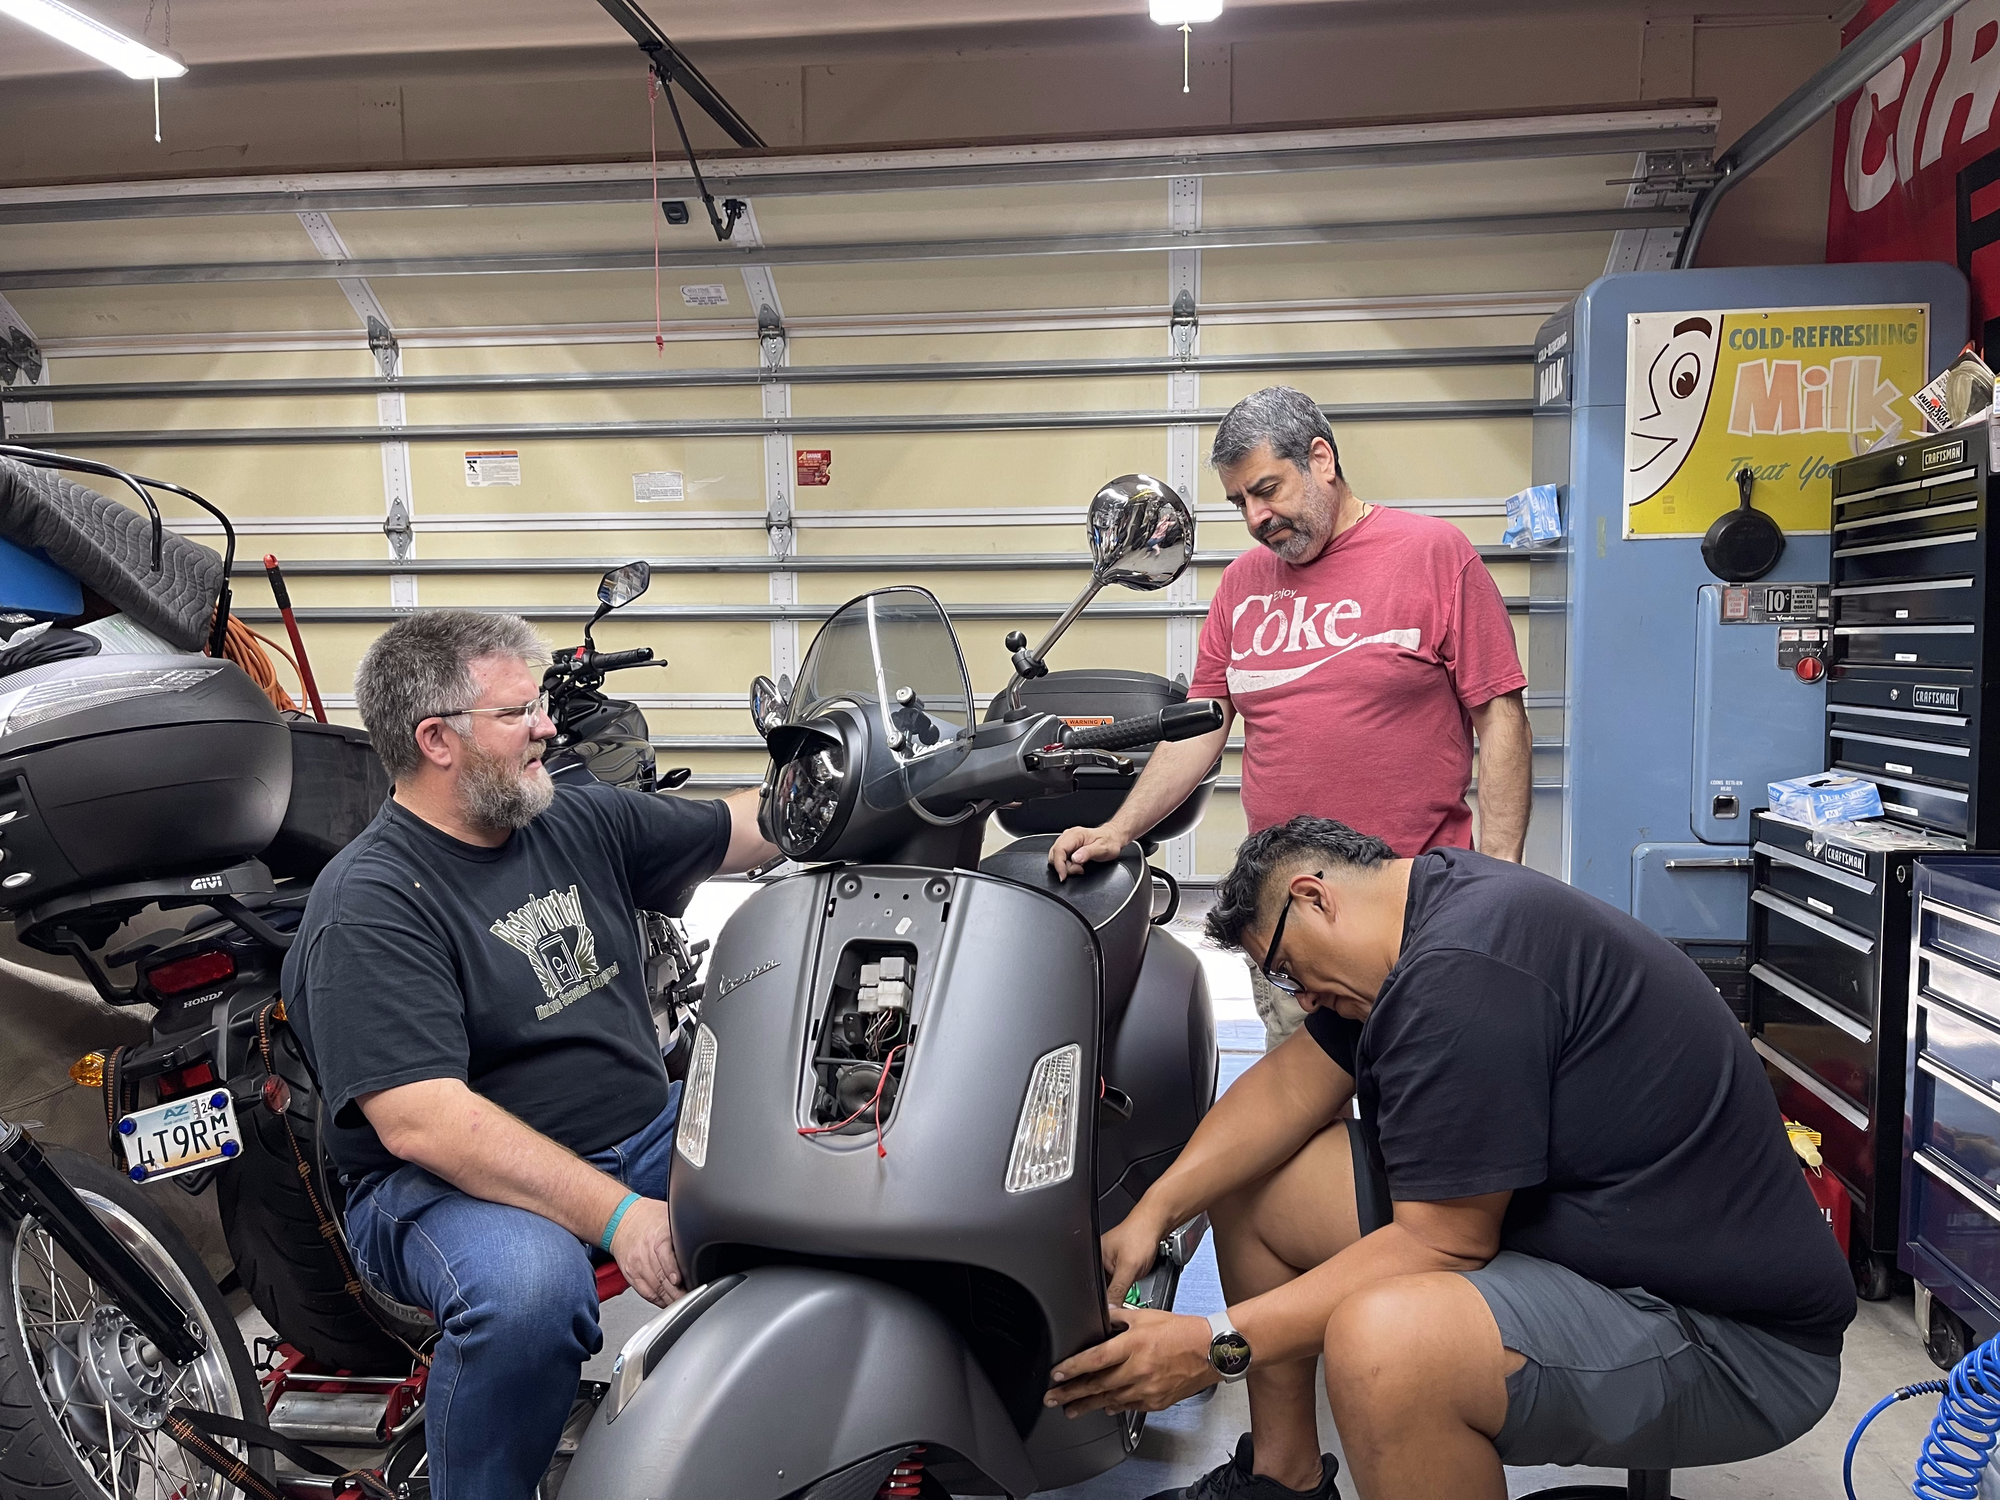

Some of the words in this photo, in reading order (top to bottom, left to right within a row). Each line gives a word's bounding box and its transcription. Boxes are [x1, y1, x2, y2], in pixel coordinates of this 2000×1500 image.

[1729, 323, 1918, 351] COLD-REFRESHING
[1540, 357, 1564, 406] MILK
[1727, 356, 1904, 437] Milk
[1925, 446, 1960, 465] CRAFTSMAN
[1231, 594, 1362, 661] Coke
[1915, 690, 1955, 706] CRAFTSMAN
[1827, 848, 1863, 870] CRAFTSMAN
[190, 875, 223, 891] GIVI
[183, 990, 223, 1009] HONDA
[163, 1103, 189, 1120] AZ
